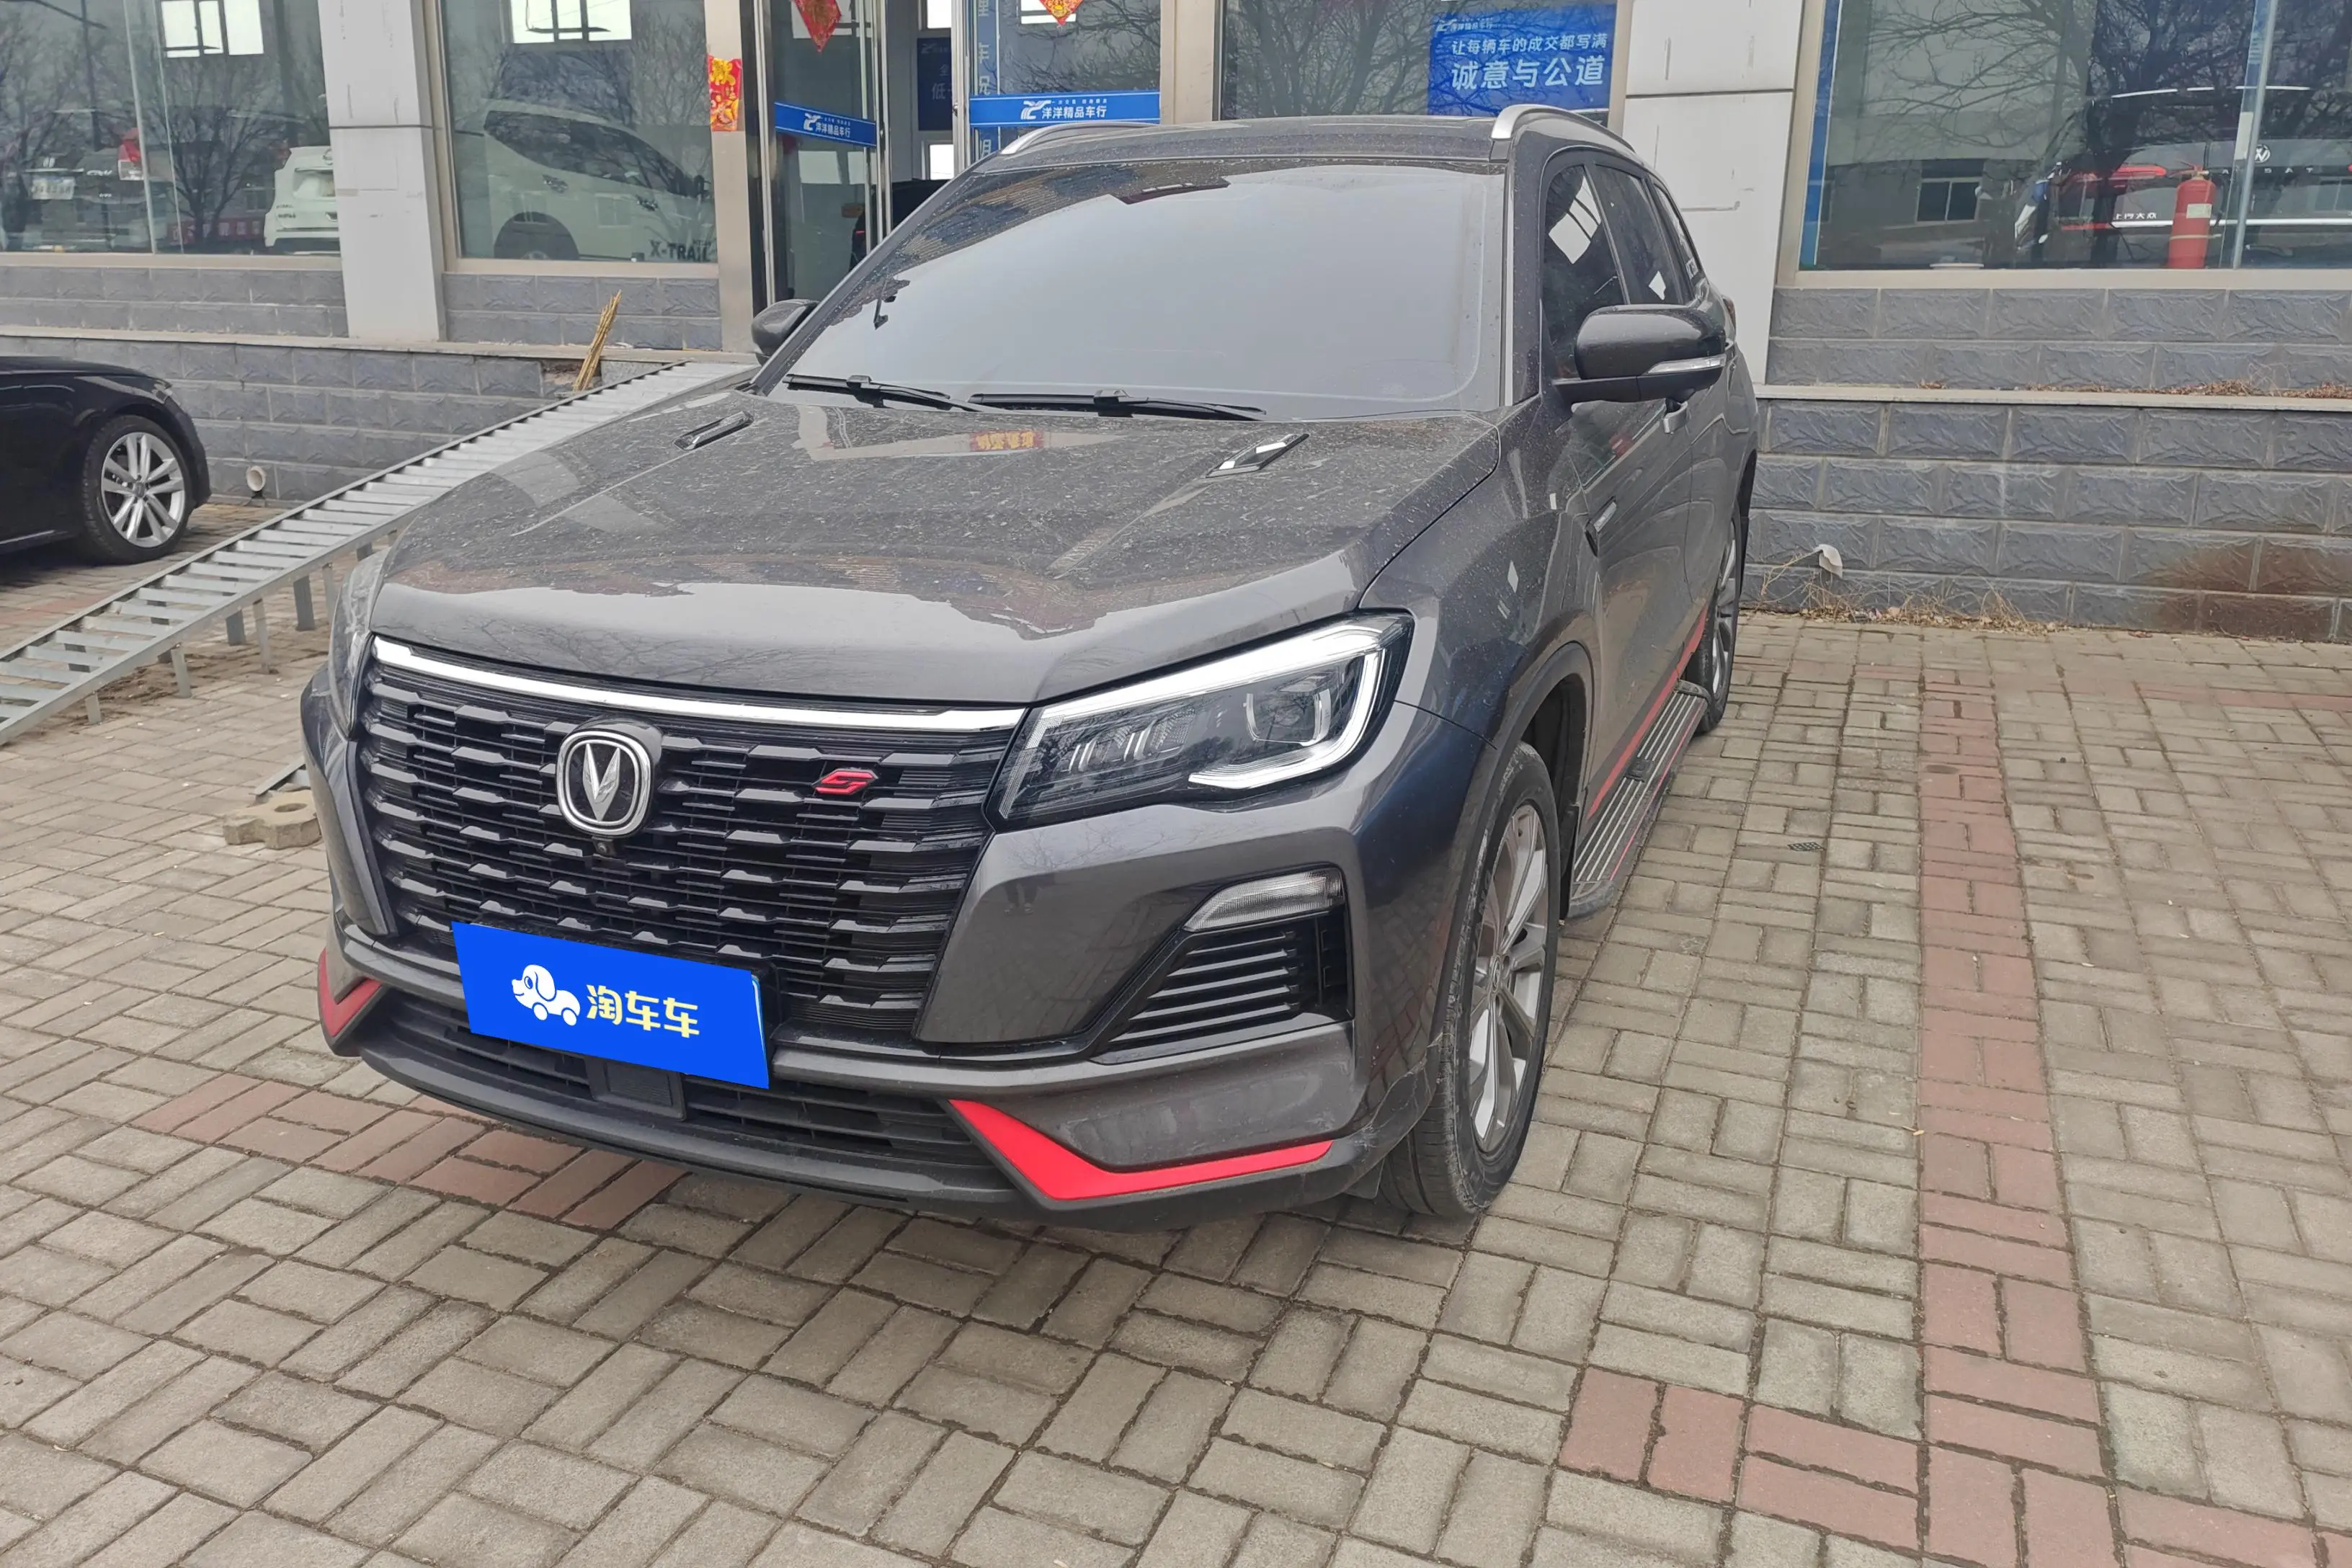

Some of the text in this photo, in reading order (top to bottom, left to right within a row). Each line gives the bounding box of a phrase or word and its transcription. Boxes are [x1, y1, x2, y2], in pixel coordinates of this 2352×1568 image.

[1451, 33, 1608, 55] 让每辆车的成交都写满
[1451, 55, 1605, 91] 诚意与公道
[1041, 105, 1108, 119] 洋洋精品车行
